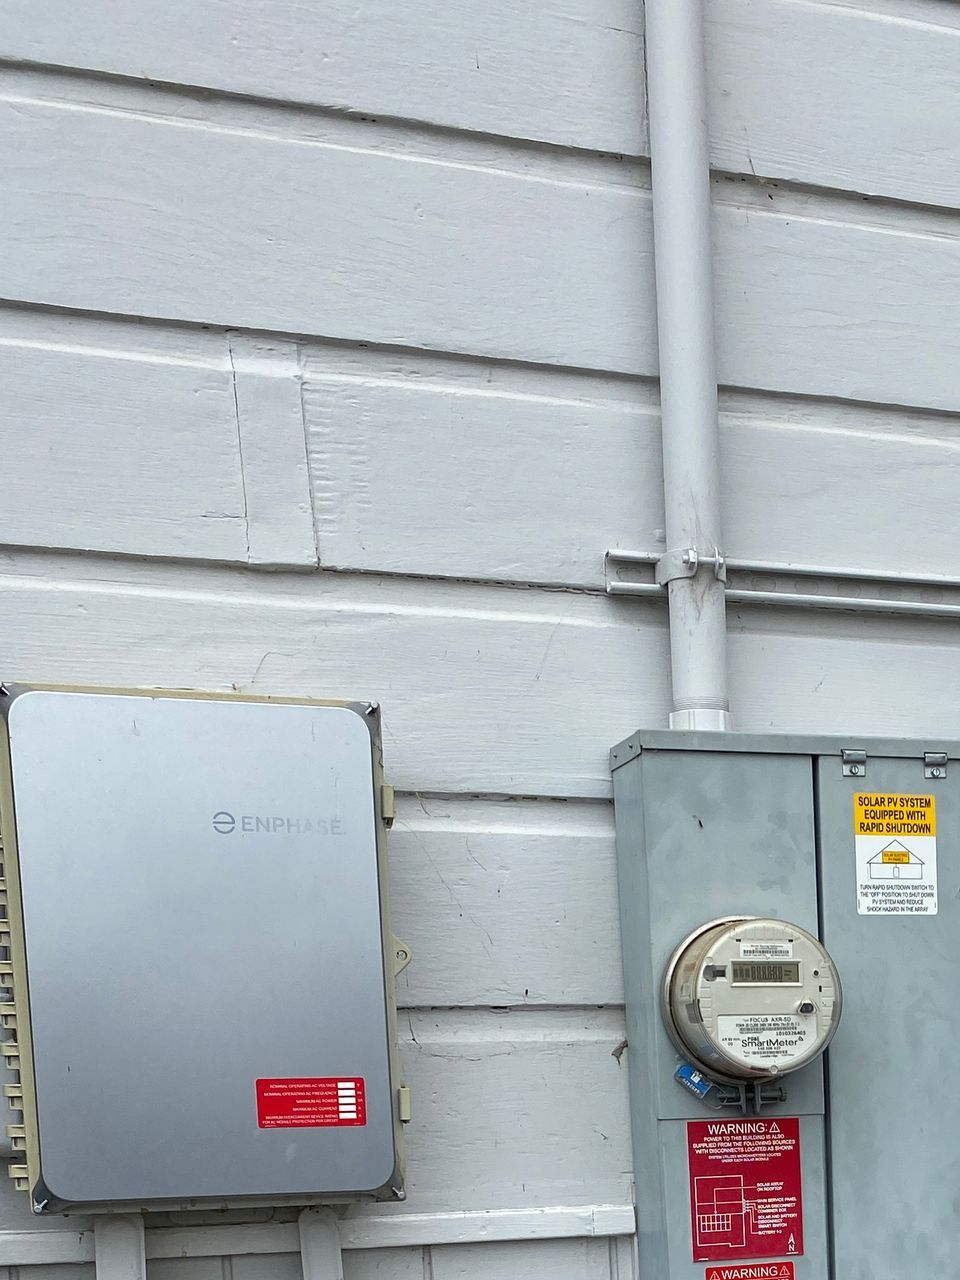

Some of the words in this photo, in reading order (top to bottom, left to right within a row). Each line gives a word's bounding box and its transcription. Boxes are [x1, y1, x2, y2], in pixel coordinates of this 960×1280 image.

[858, 796, 886, 807] SOLAR
[887, 797, 898, 807] PV
[899, 797, 931, 808] SYSTEM
[864, 809, 904, 820] EQUIPPED
[906, 810, 926, 820] WITH
[241, 815, 342, 836] ENPHASE
[859, 822, 884, 833] RAPID
[886, 822, 931, 833] SHUTDOWN
[741, 1038, 797, 1047] SmartMeter
[721, 1266, 778, 1280] WARNING
